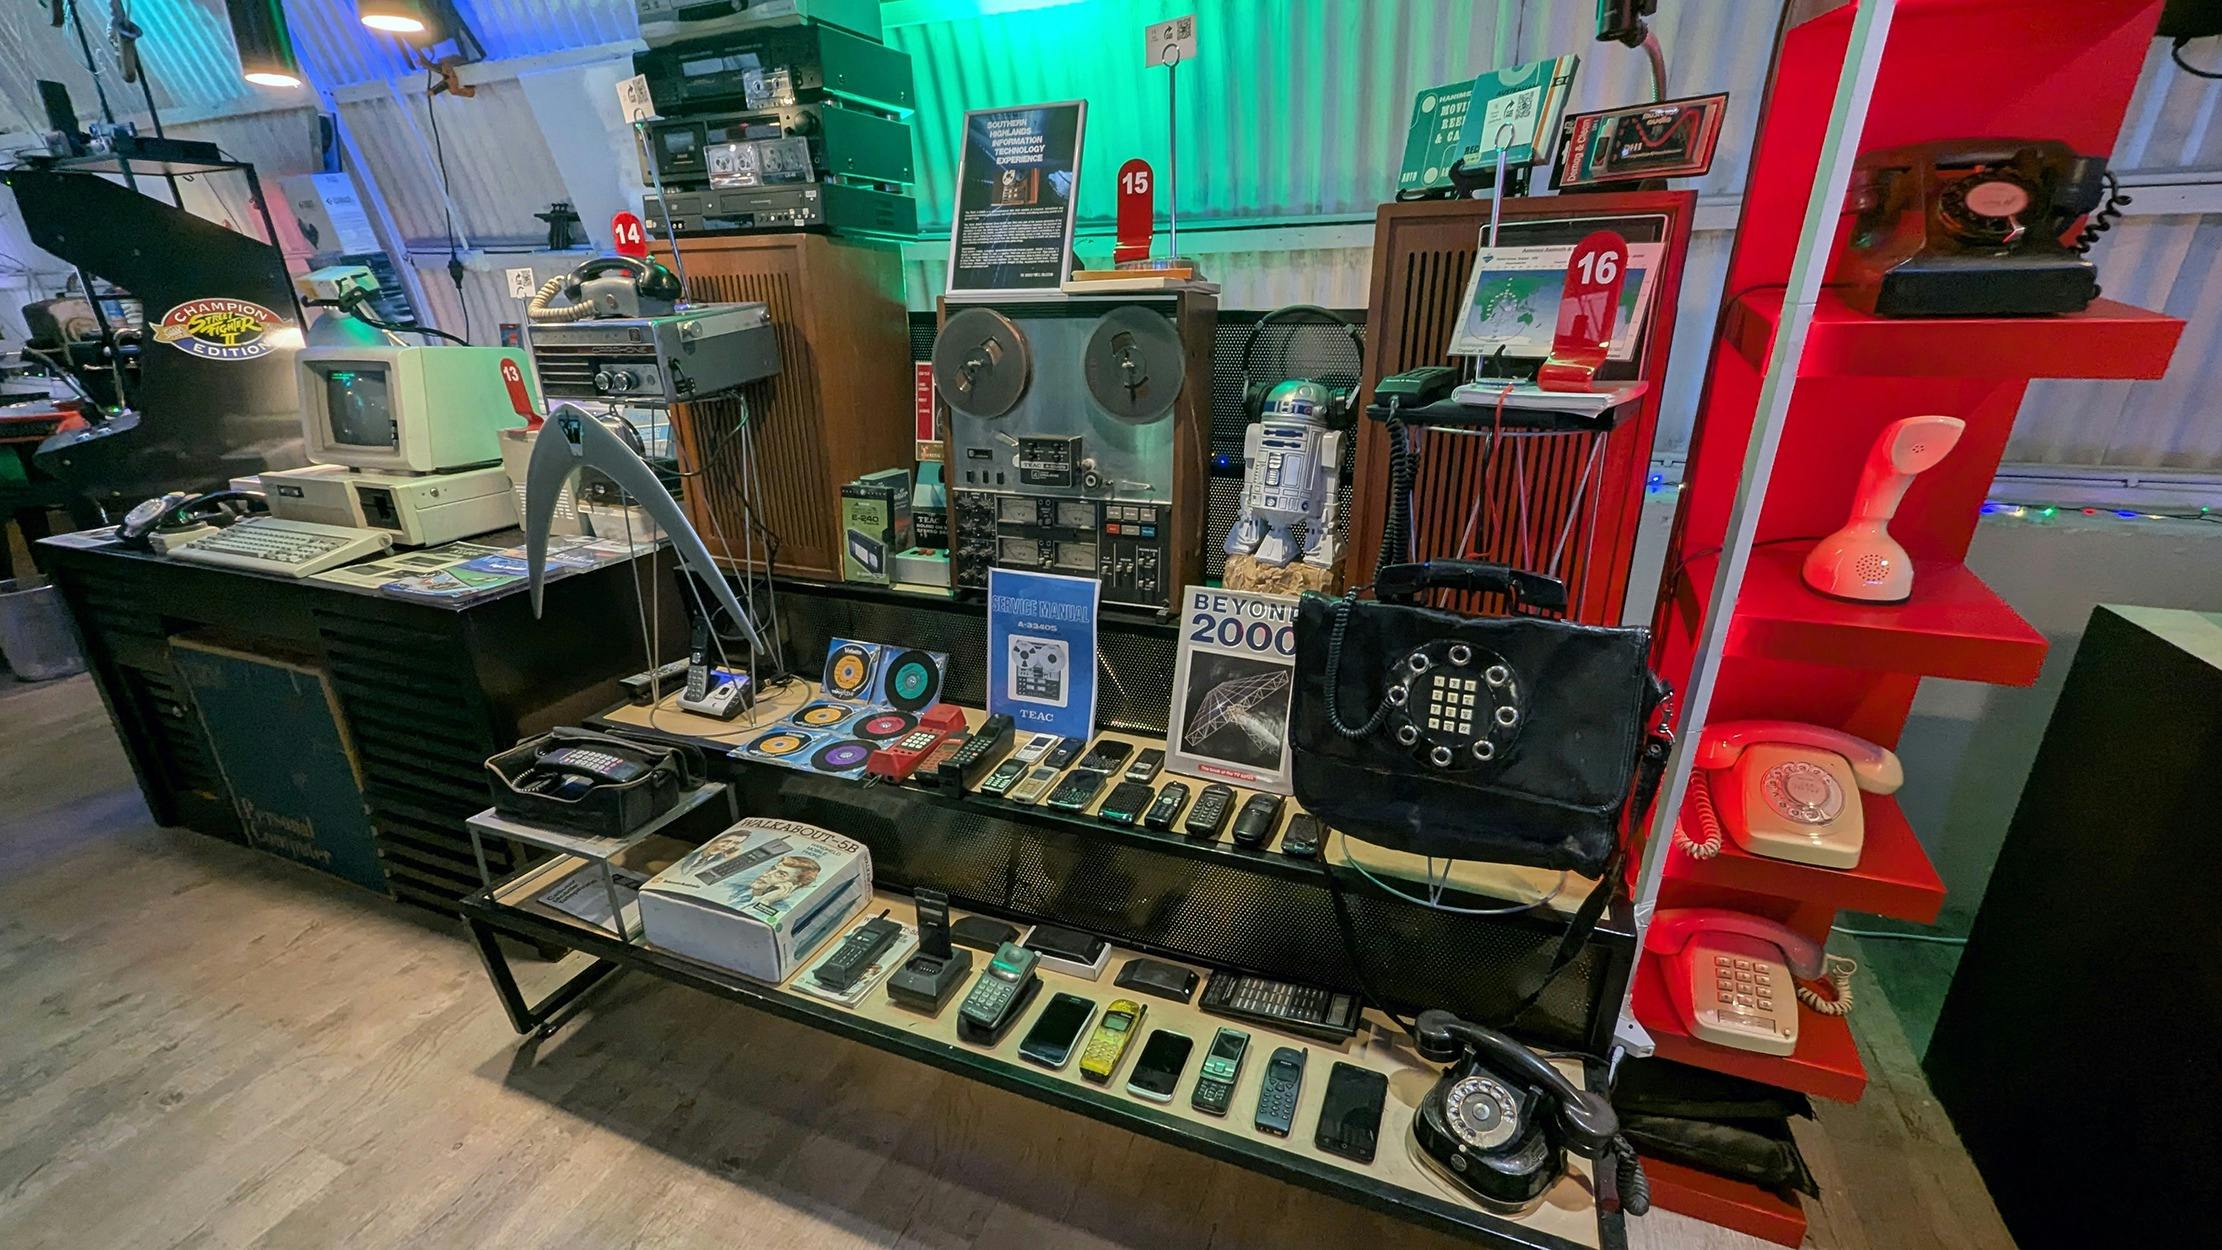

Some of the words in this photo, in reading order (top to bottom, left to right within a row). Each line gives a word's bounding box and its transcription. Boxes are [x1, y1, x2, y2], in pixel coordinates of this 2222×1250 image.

[1440, 101, 1470, 116] MOVI
[987, 118, 1027, 129] SOUTHERN
[990, 127, 1031, 138] HIGHLANDS
[992, 136, 1042, 147] INFORMATION
[994, 145, 1045, 155] TECHNOLOGY
[996, 154, 1043, 165] EXPERIENCE
[1122, 171, 1149, 195] 15
[615, 223, 640, 245] 14
[1577, 251, 1618, 285] 16
[174, 302, 268, 323] CHAMPION
[188, 311, 233, 334] STREET
[201, 316, 263, 336] FIGHTER
[193, 342, 271, 357] EDITION
[503, 366, 519, 382] 13
[992, 594, 1038, 616] SERVICE
[1039, 600, 1090, 623] MANUAL
[1018, 621, 1057, 632] A-3340S
[1190, 613, 1297, 656] 2000
[1020, 709, 1054, 721] TEAC
[741, 818, 860, 854] WALKABOUT-5B
